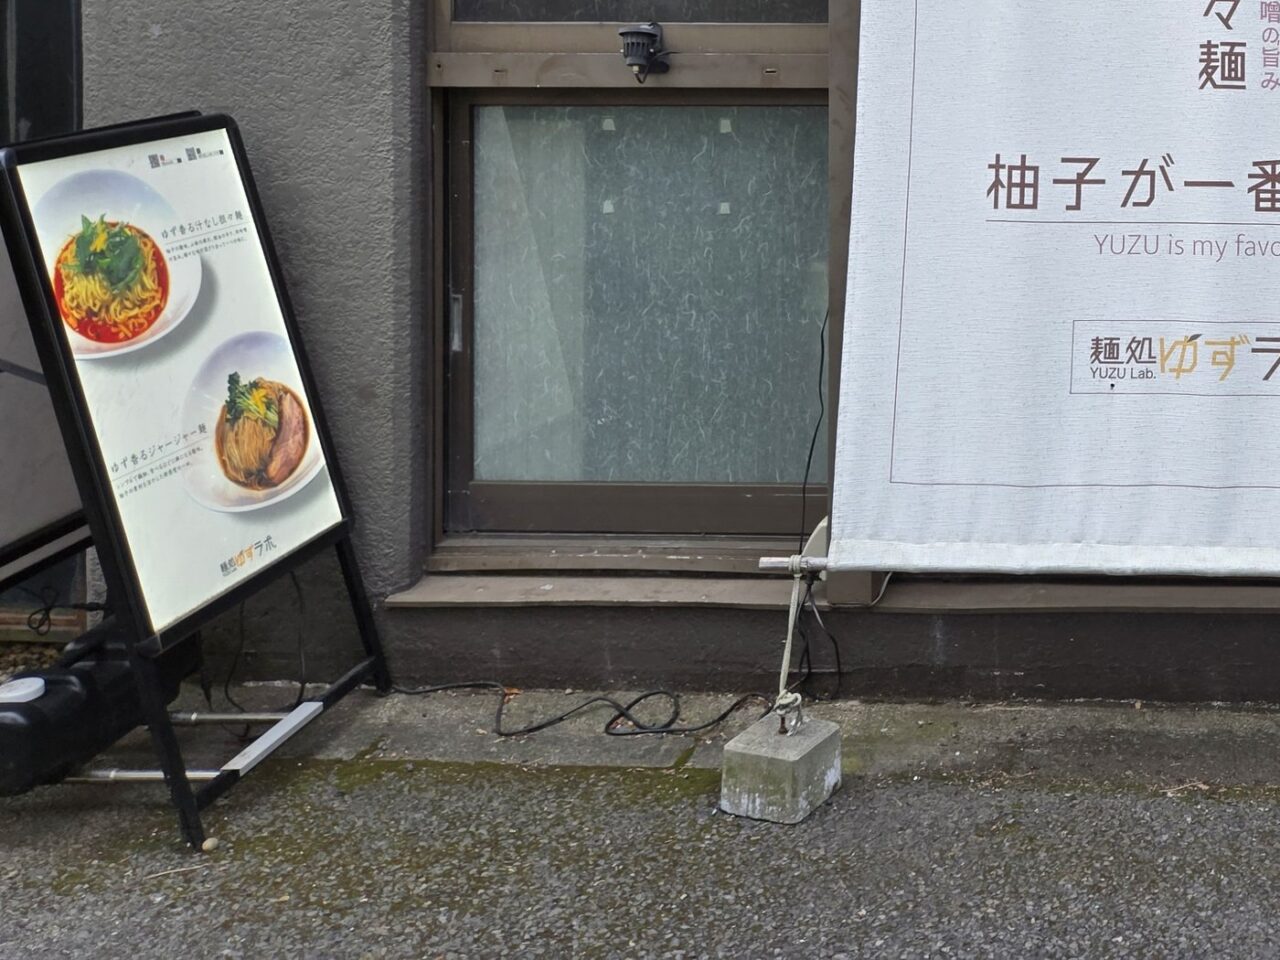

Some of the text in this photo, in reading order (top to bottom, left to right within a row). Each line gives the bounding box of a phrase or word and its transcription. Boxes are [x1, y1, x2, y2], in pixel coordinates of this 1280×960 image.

[1094, 234, 1160, 255] YUZU
[1168, 234, 1184, 255] is
[1193, 239, 1228, 263] my
[1090, 367, 1157, 379] YUZU Lab.
